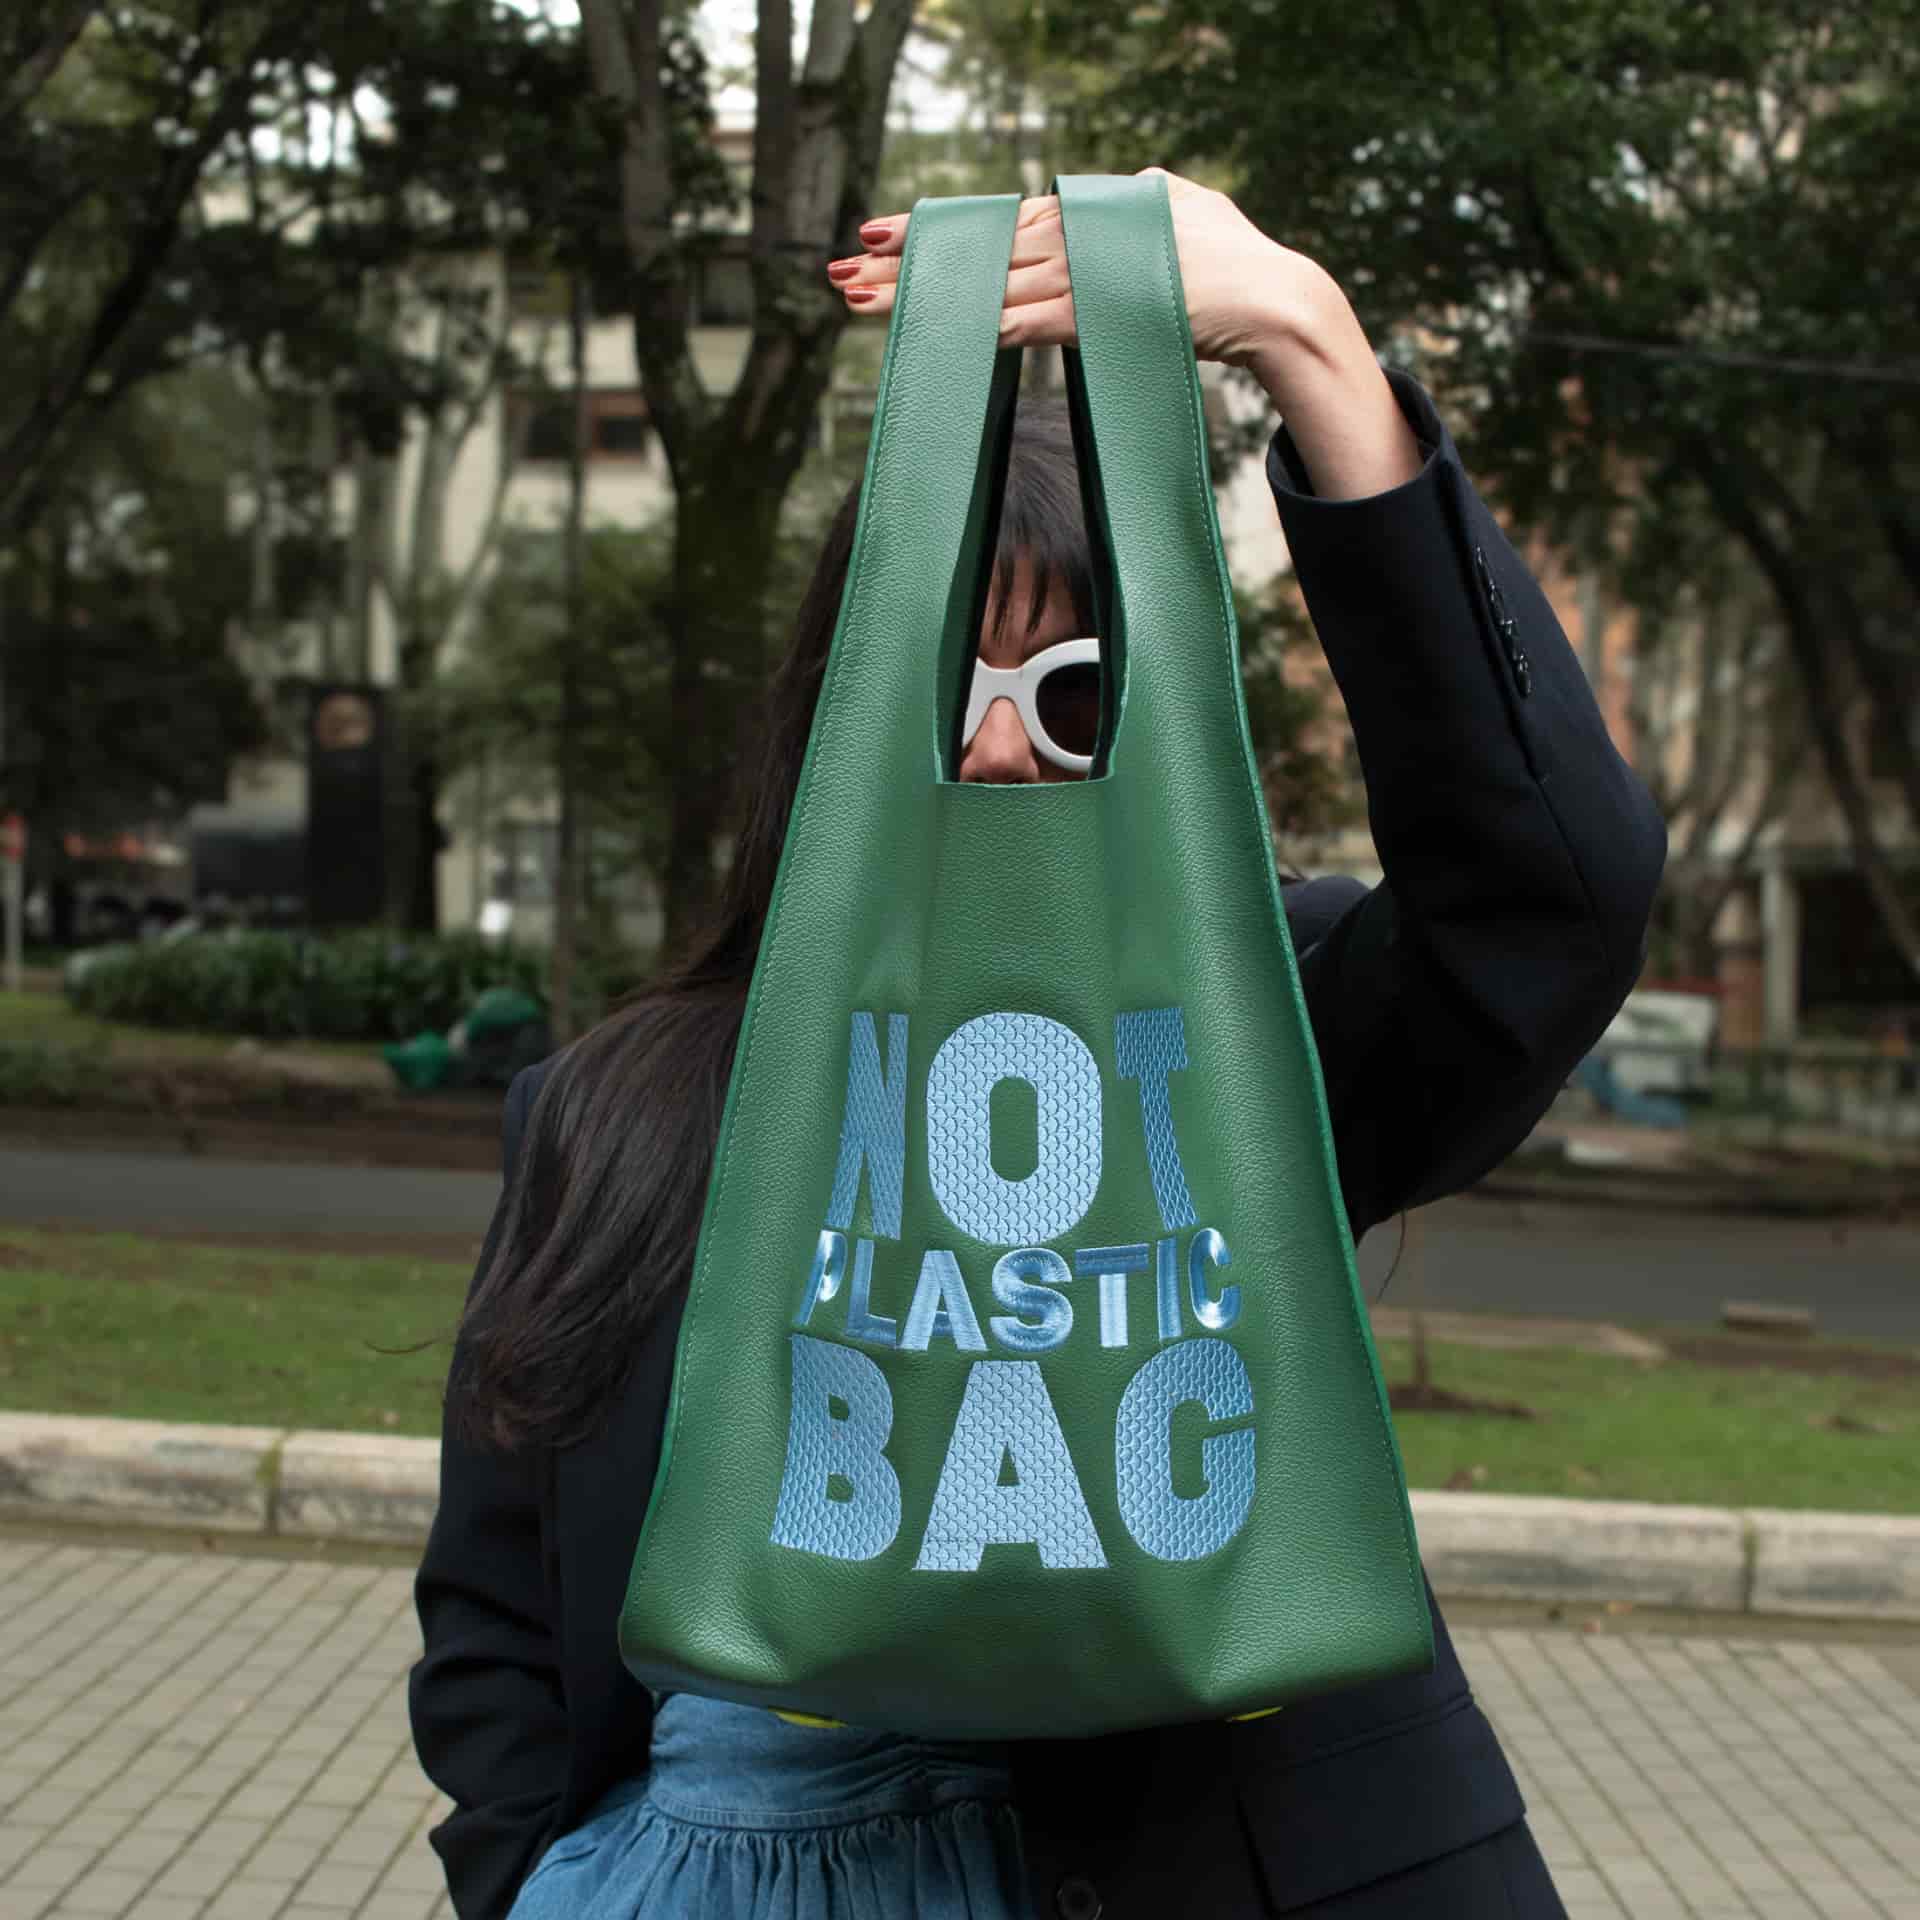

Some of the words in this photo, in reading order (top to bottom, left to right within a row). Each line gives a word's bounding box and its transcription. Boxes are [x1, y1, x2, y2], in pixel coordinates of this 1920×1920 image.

[825, 1007, 1198, 1247] NOT
[793, 1227, 1242, 1352] PLASTIC
[769, 1333, 1257, 1572] BAG
